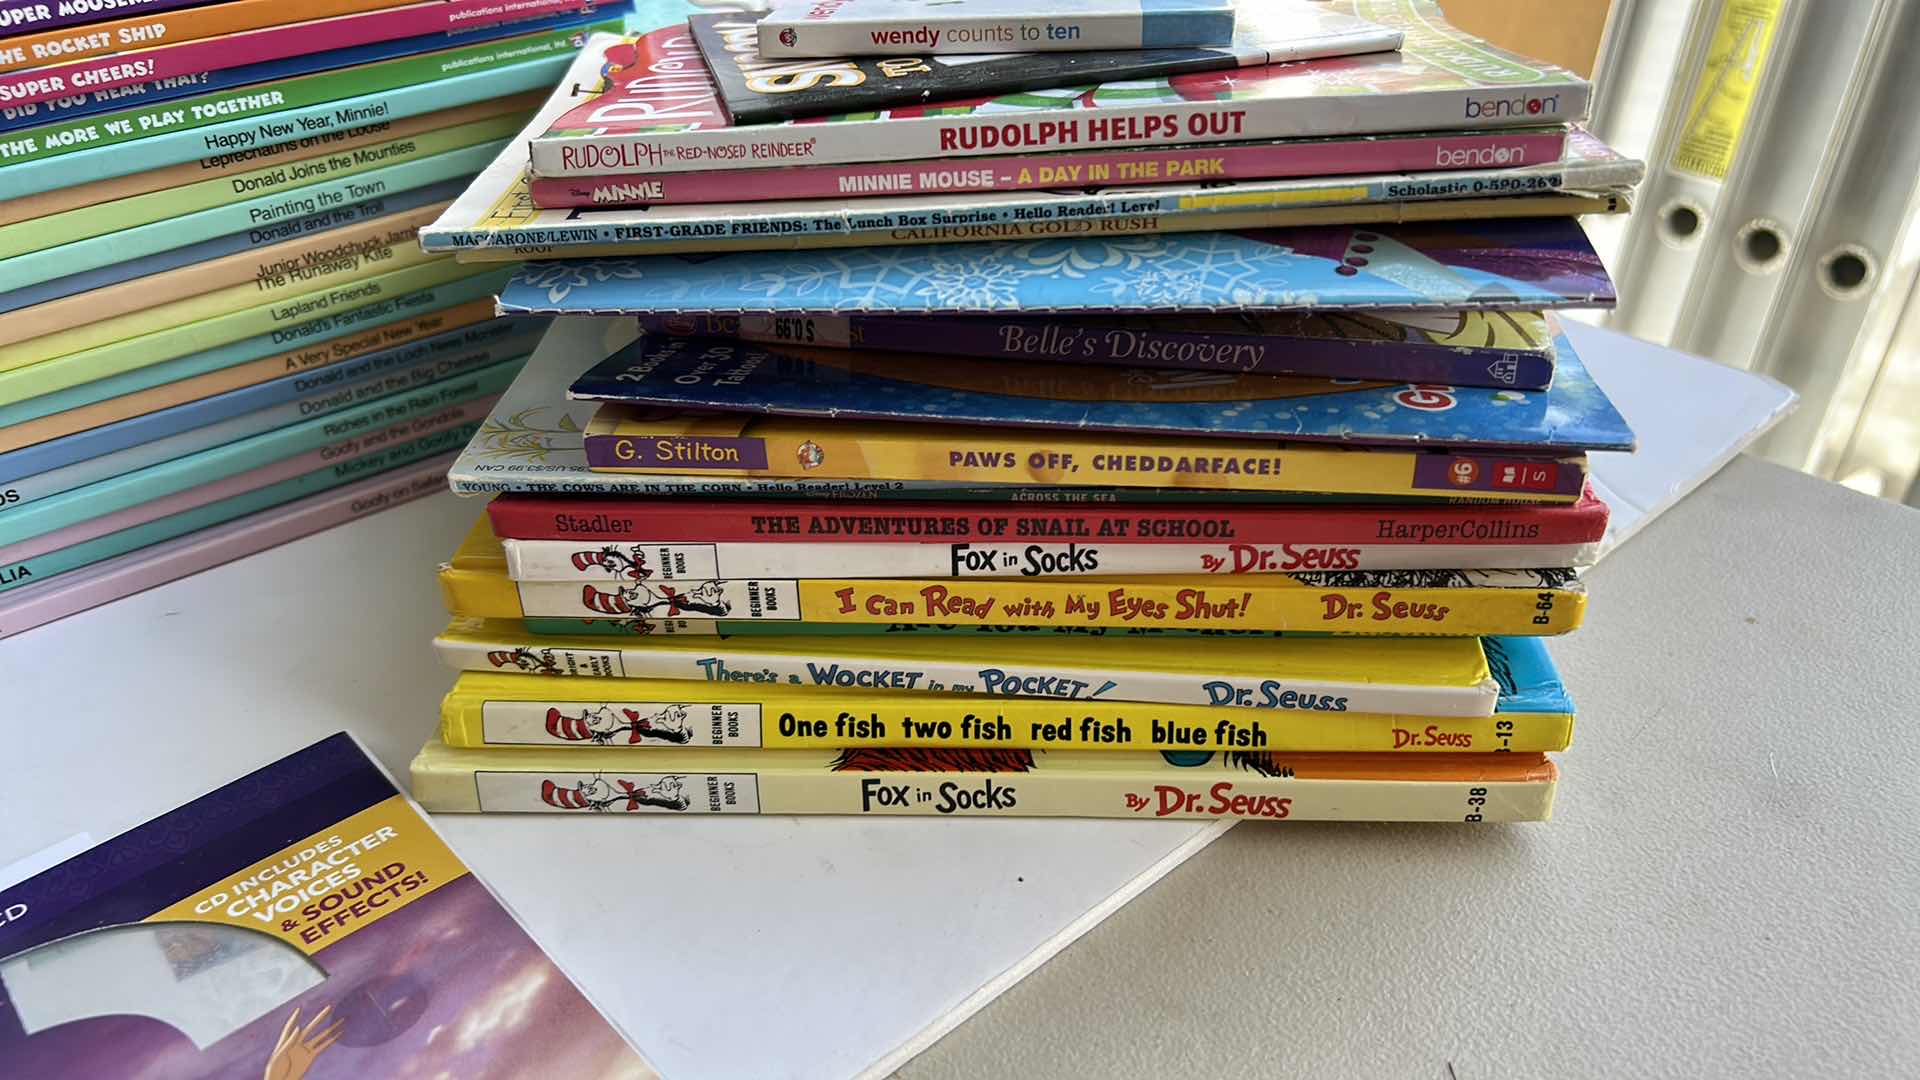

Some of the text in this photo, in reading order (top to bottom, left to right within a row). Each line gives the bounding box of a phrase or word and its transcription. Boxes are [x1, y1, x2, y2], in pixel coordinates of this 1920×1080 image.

[32, 23, 167, 59] ROCKET SHIP
[871, 24, 1080, 48] wendy counts to ten
[0, 59, 154, 102] SUPER CHEERS!
[45, 126, 100, 150] MORE
[104, 115, 133, 138] WE
[138, 108, 187, 132] PLAY
[191, 91, 285, 121] TOGETHER
[1465, 94, 1557, 118] bendon
[204, 101, 389, 151] Happy New Year, Minnie!
[939, 111, 1246, 151] RUDOLPH HELPS OUT
[200, 123, 391, 169] Leprechauns on the Loose
[562, 142, 664, 171] RUDOLPH
[676, 142, 747, 161] RED-NOSED
[1436, 144, 1527, 167] bendon
[232, 140, 417, 194] Donald Joins the Mounties
[838, 158, 1225, 193] MINNIE MOUSE A DAY IN THE PARK
[250, 180, 386, 224] Painting the Town
[593, 181, 665, 204] MINNIE
[250, 222, 301, 245] Donald
[304, 215, 331, 231] and
[333, 207, 355, 221] the
[614, 223, 726, 241] FIRST-GRADE
[731, 219, 809, 236] FRIENDS:
[811, 217, 842, 231] The
[847, 215, 893, 230] Lunch
[899, 212, 927, 227] Box
[931, 209, 997, 225] Surprise
[1014, 206, 1053, 220] Hello
[891, 217, 1160, 241] CALIFORNIA GOLD RUSH
[254, 246, 393, 292] The Runaway Kite
[256, 257, 301, 279] Junior
[271, 282, 381, 322] Lapland Friends
[271, 321, 333, 345] Donald's
[285, 358, 296, 372] A
[297, 350, 330, 367] Very
[332, 334, 381, 359] Special
[383, 324, 413, 341] New
[1000, 324, 1265, 373] Belle's Discovery
[615, 440, 740, 462] G. Stilton
[949, 450, 1282, 477] PAWS OFF, CHEDDARFACE!
[463, 483, 511, 492] YOUNG
[526, 483, 557, 492] THE
[562, 483, 606, 492] COWS
[610, 483, 640, 492] ARE
[645, 483, 661, 492] IN
[665, 483, 696, 492] THE
[701, 483, 741, 492] CORN
[757, 483, 793, 492] Hello
[800, 481, 850, 491] Reader!
[894, 481, 904, 490] 2
[555, 514, 1540, 544] Stadler THE ADVENTURES OF SNAIL AT SCHOOL HarperCollins
[660, 548, 673, 579] BEGINNER
[675, 552, 686, 574] BOOKS
[1003, 552, 1018, 567] in
[1021, 543, 1098, 577] Socks
[1200, 554, 1225, 573] By
[1229, 543, 1277, 575] Dr.
[1281, 543, 1361, 571] Seuss
[748, 581, 762, 617] BEGINNER
[765, 587, 777, 611] BOOKS
[835, 585, 1450, 621] I Can Read with My Eyes Shut! Dr. Seuss
[1532, 592, 1554, 625] B-64
[697, 657, 779, 685] There's
[787, 673, 802, 685] a
[807, 662, 923, 690] WOCKET
[979, 668, 1118, 700] POCKET!
[1202, 681, 1253, 706] Dr.
[1256, 680, 1348, 712] Seuss
[711, 705, 723, 745] BEGINNER
[728, 711, 739, 738] BOOKS
[778, 712, 1473, 749] One fish two fish red fish blue fish Dr. Seuss
[710, 776, 721, 812] BEGINNER
[726, 782, 737, 805] BOOKS
[861, 778, 1293, 818] Fox in Socks By Dr. Seuss
[1465, 787, 1488, 823] B-38
[194, 835, 343, 915] CD INCLUDES
[226, 825, 399, 918] CHARACTER
[252, 863, 362, 923] VOICES
[281, 862, 406, 932] & SOUND
[299, 870, 429, 945] EFFECTS!
